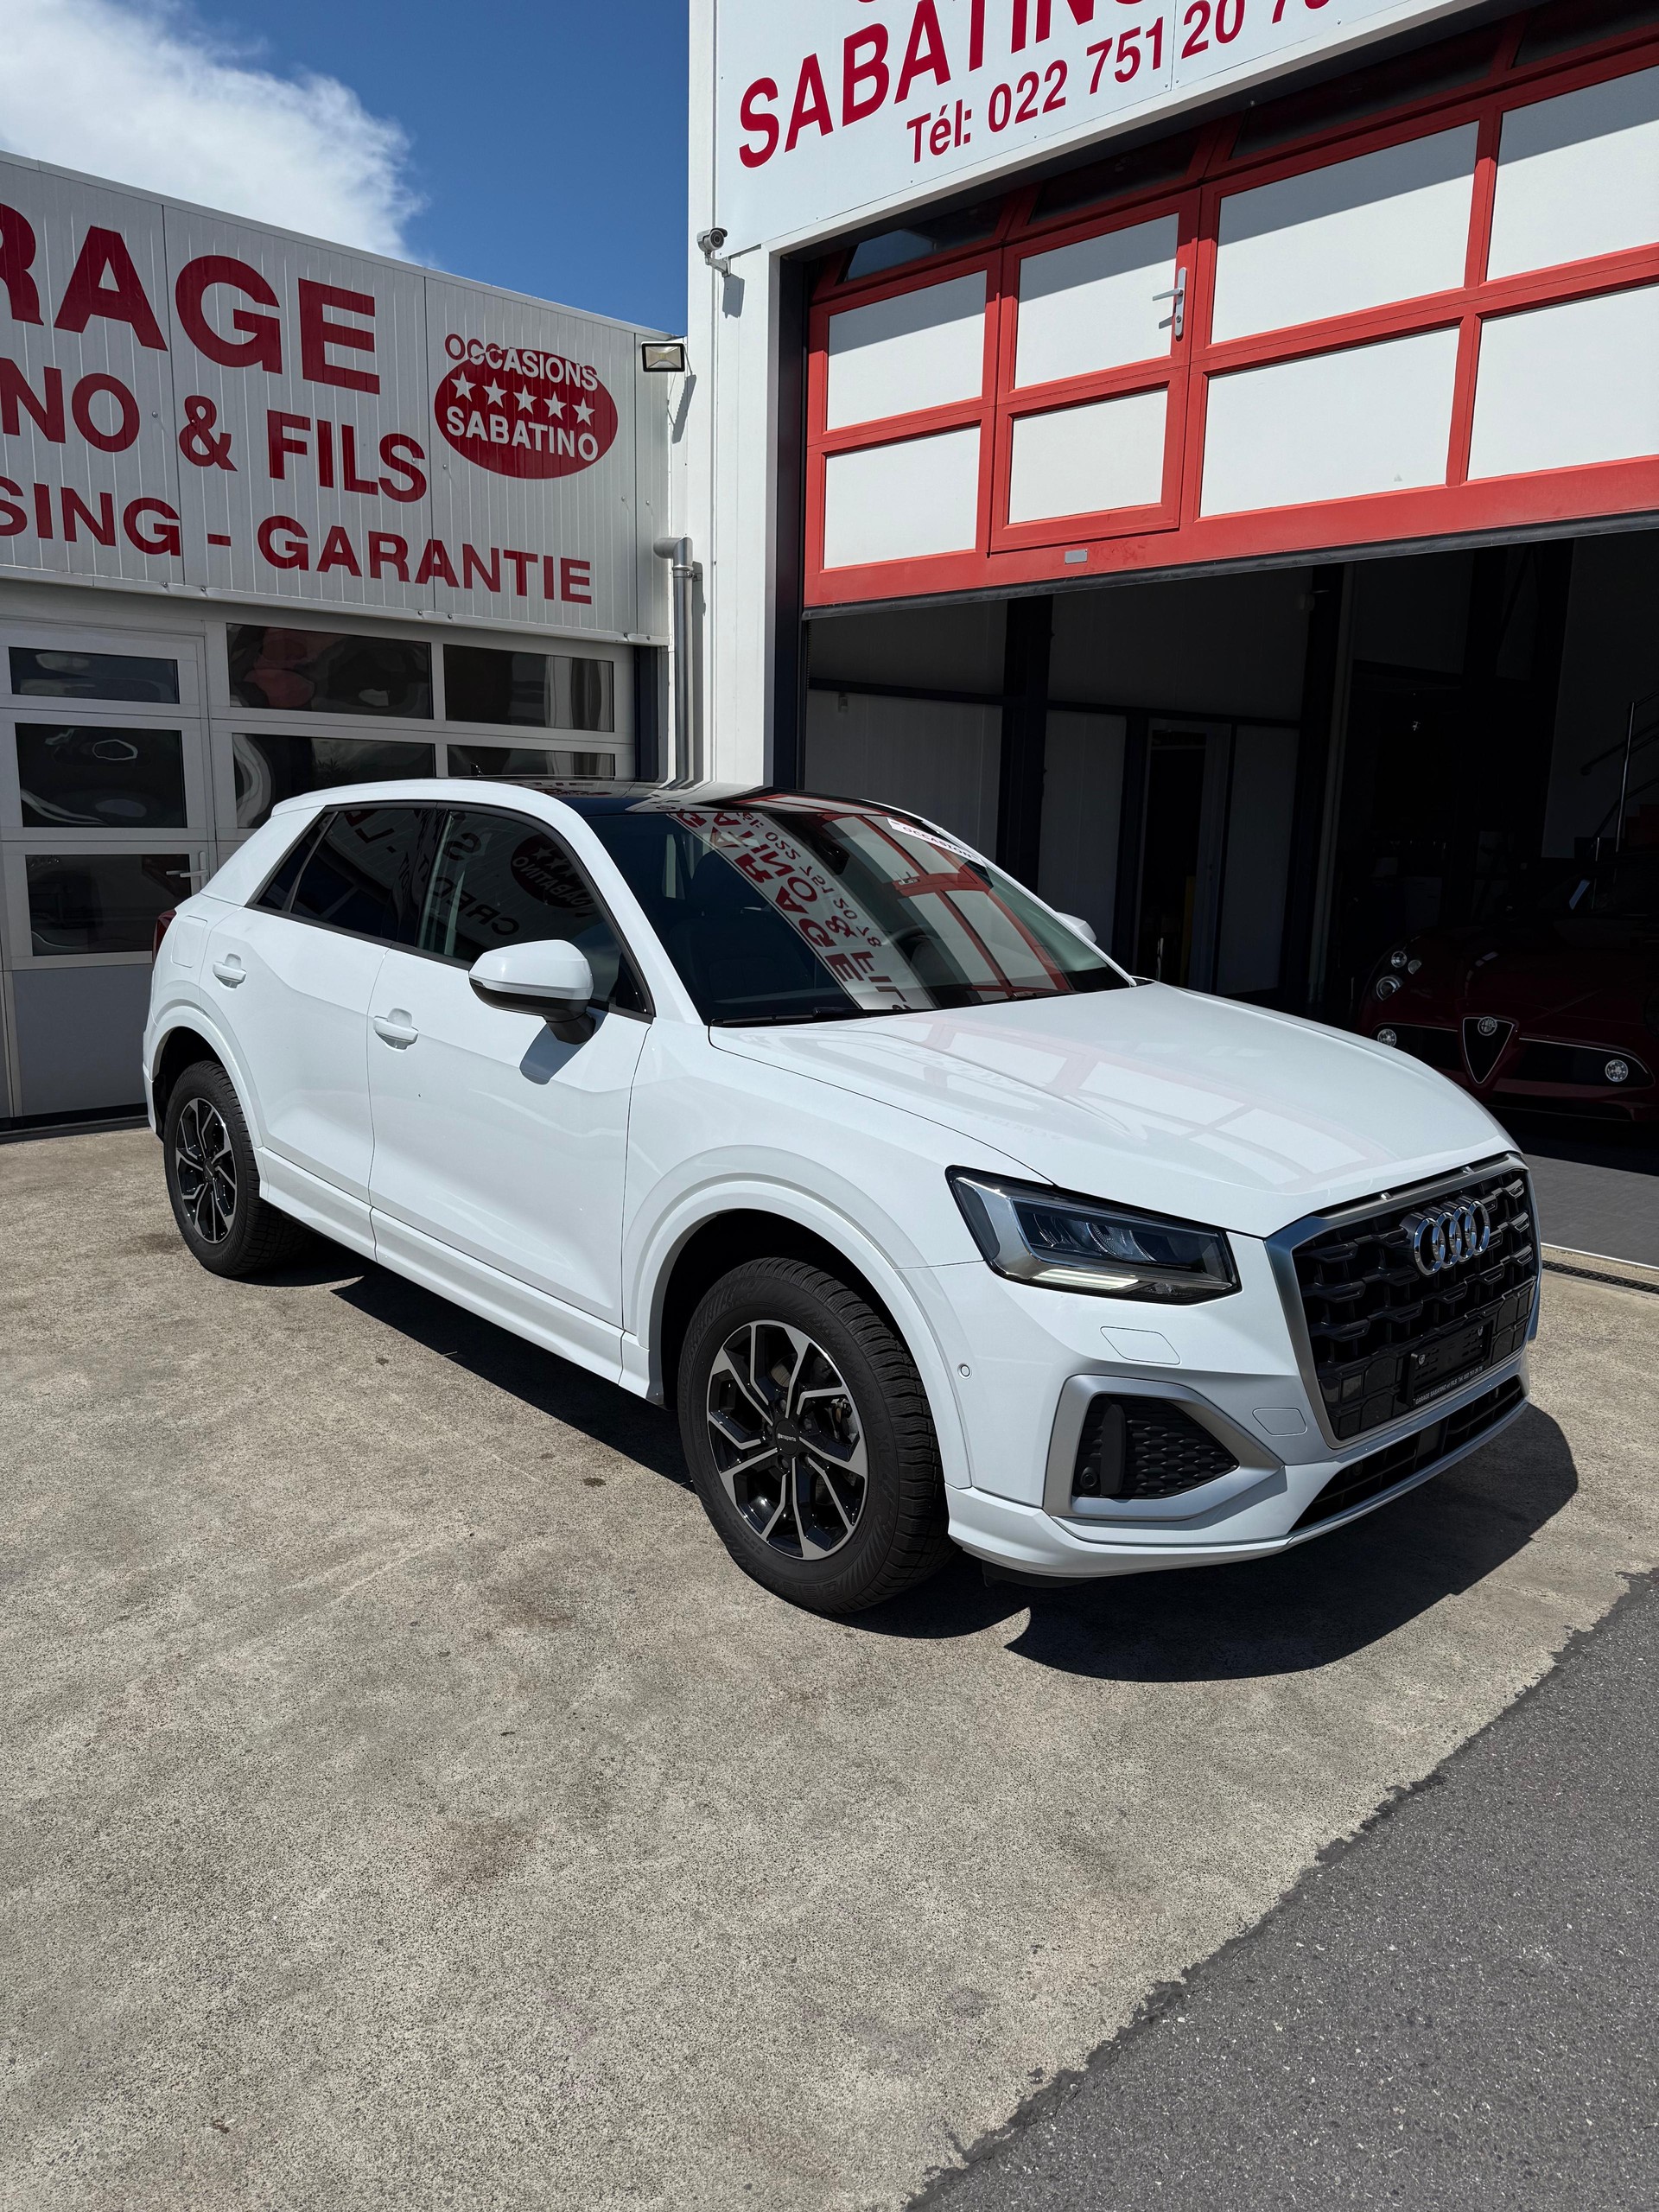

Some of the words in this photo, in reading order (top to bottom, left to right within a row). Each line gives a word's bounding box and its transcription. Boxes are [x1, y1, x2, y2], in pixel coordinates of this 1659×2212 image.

[906, 99, 973, 164] Tél:
[988, 58, 1068, 133] 022
[1085, 16, 1164, 95] 751
[1180, 0, 1246, 60] 20
[444, 333, 598, 391] OCCASIONS
[178, 394, 238, 472] &
[266, 409, 427, 503] FILS
[446, 405, 599, 461] SABATINO
[257, 514, 593, 606] GARANTIE
